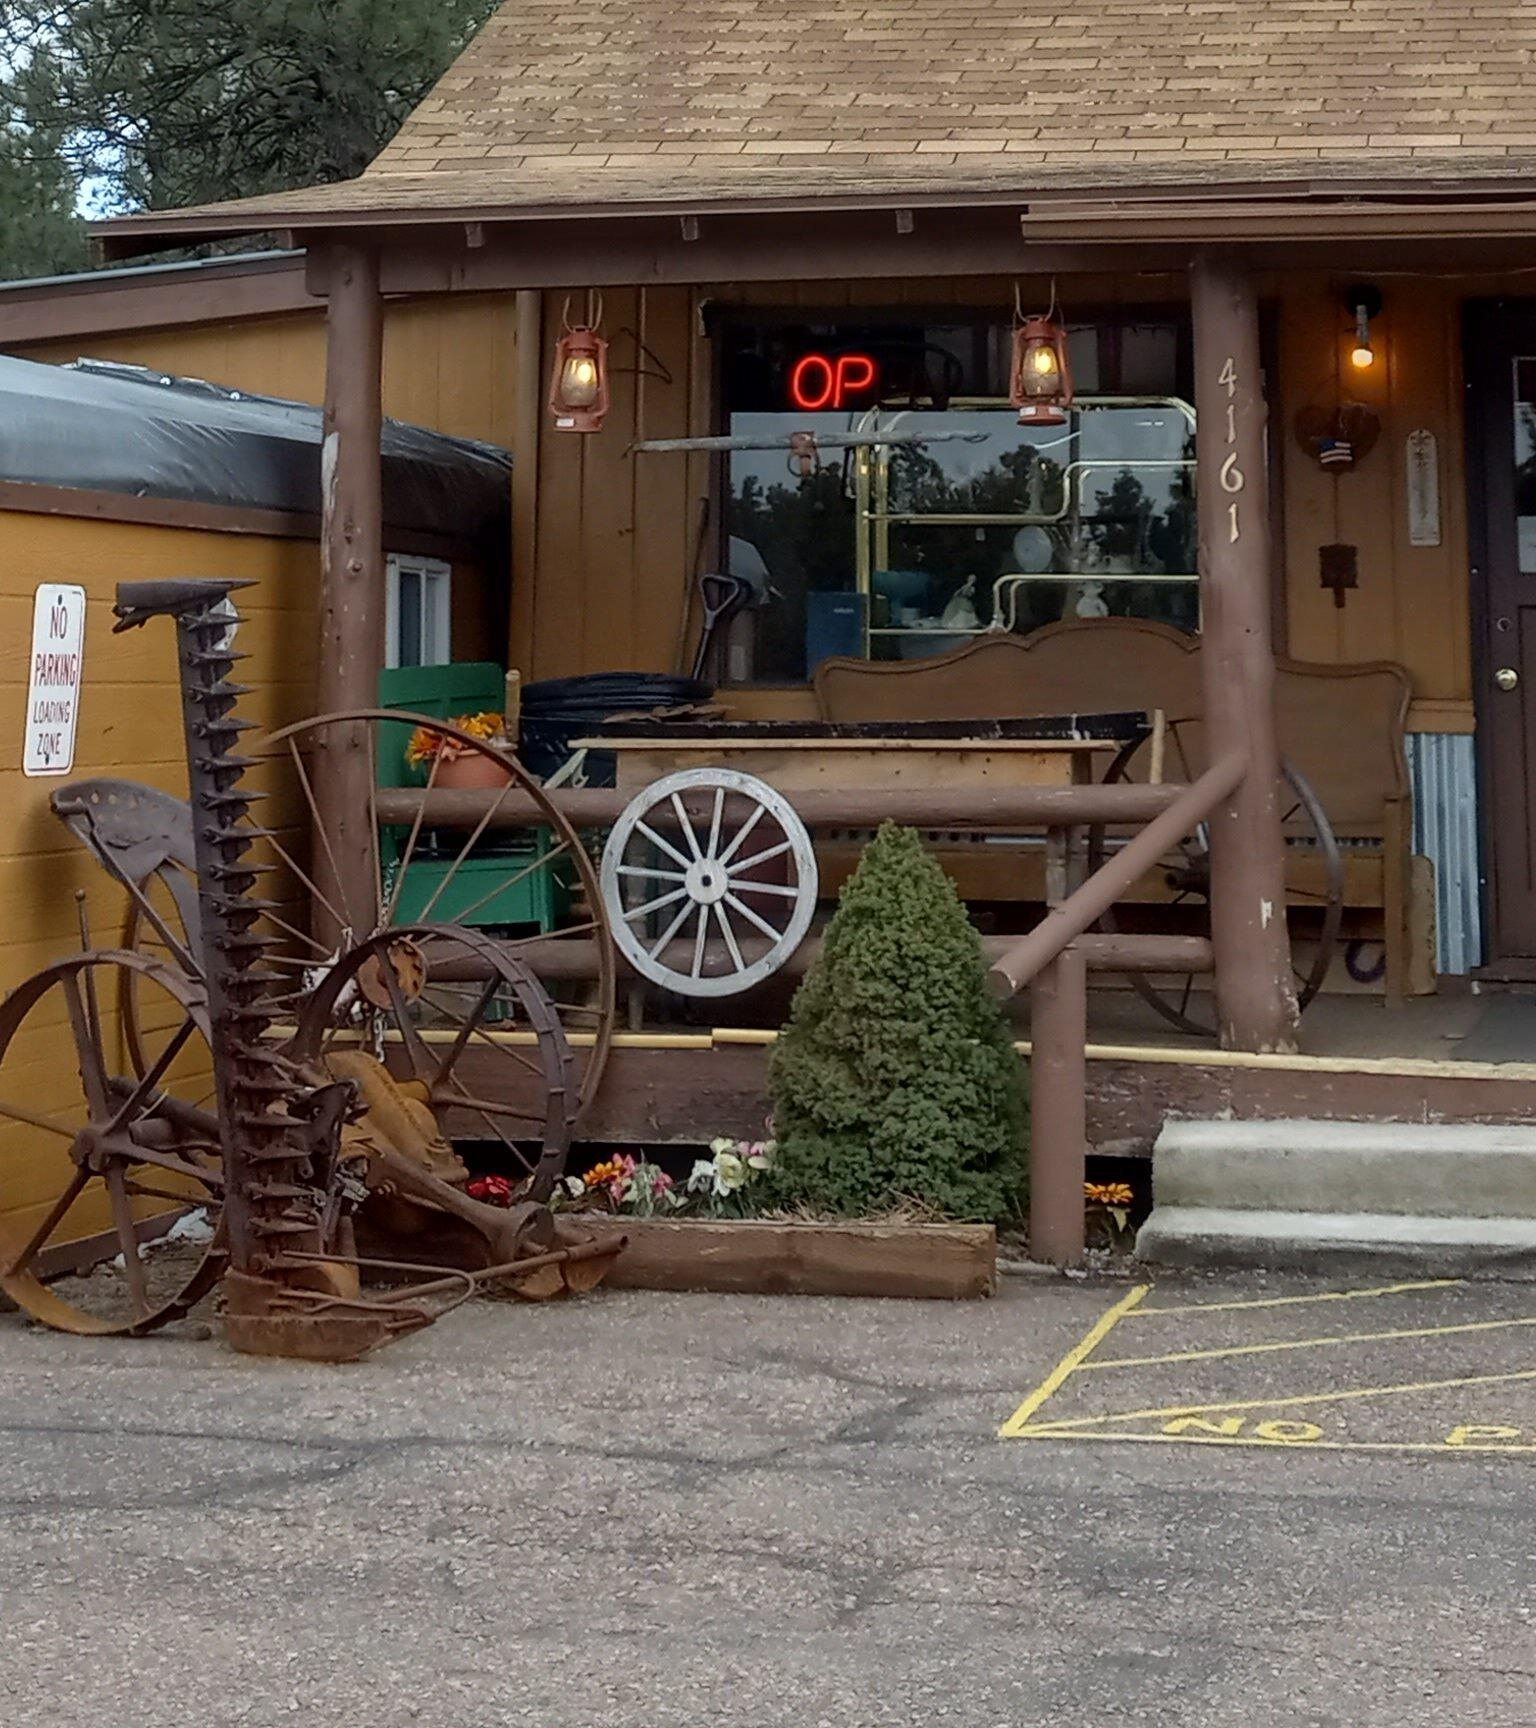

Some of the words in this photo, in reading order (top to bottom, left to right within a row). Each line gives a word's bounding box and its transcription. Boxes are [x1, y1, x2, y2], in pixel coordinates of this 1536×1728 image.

[793, 355, 874, 409] OP
[1218, 357, 1245, 544] 4161
[49, 606, 68, 639] NO
[34, 653, 77, 687] PARKING
[33, 700, 71, 725] LOADING
[36, 732, 62, 756] ZONE
[1162, 1415, 1247, 1436] NO
